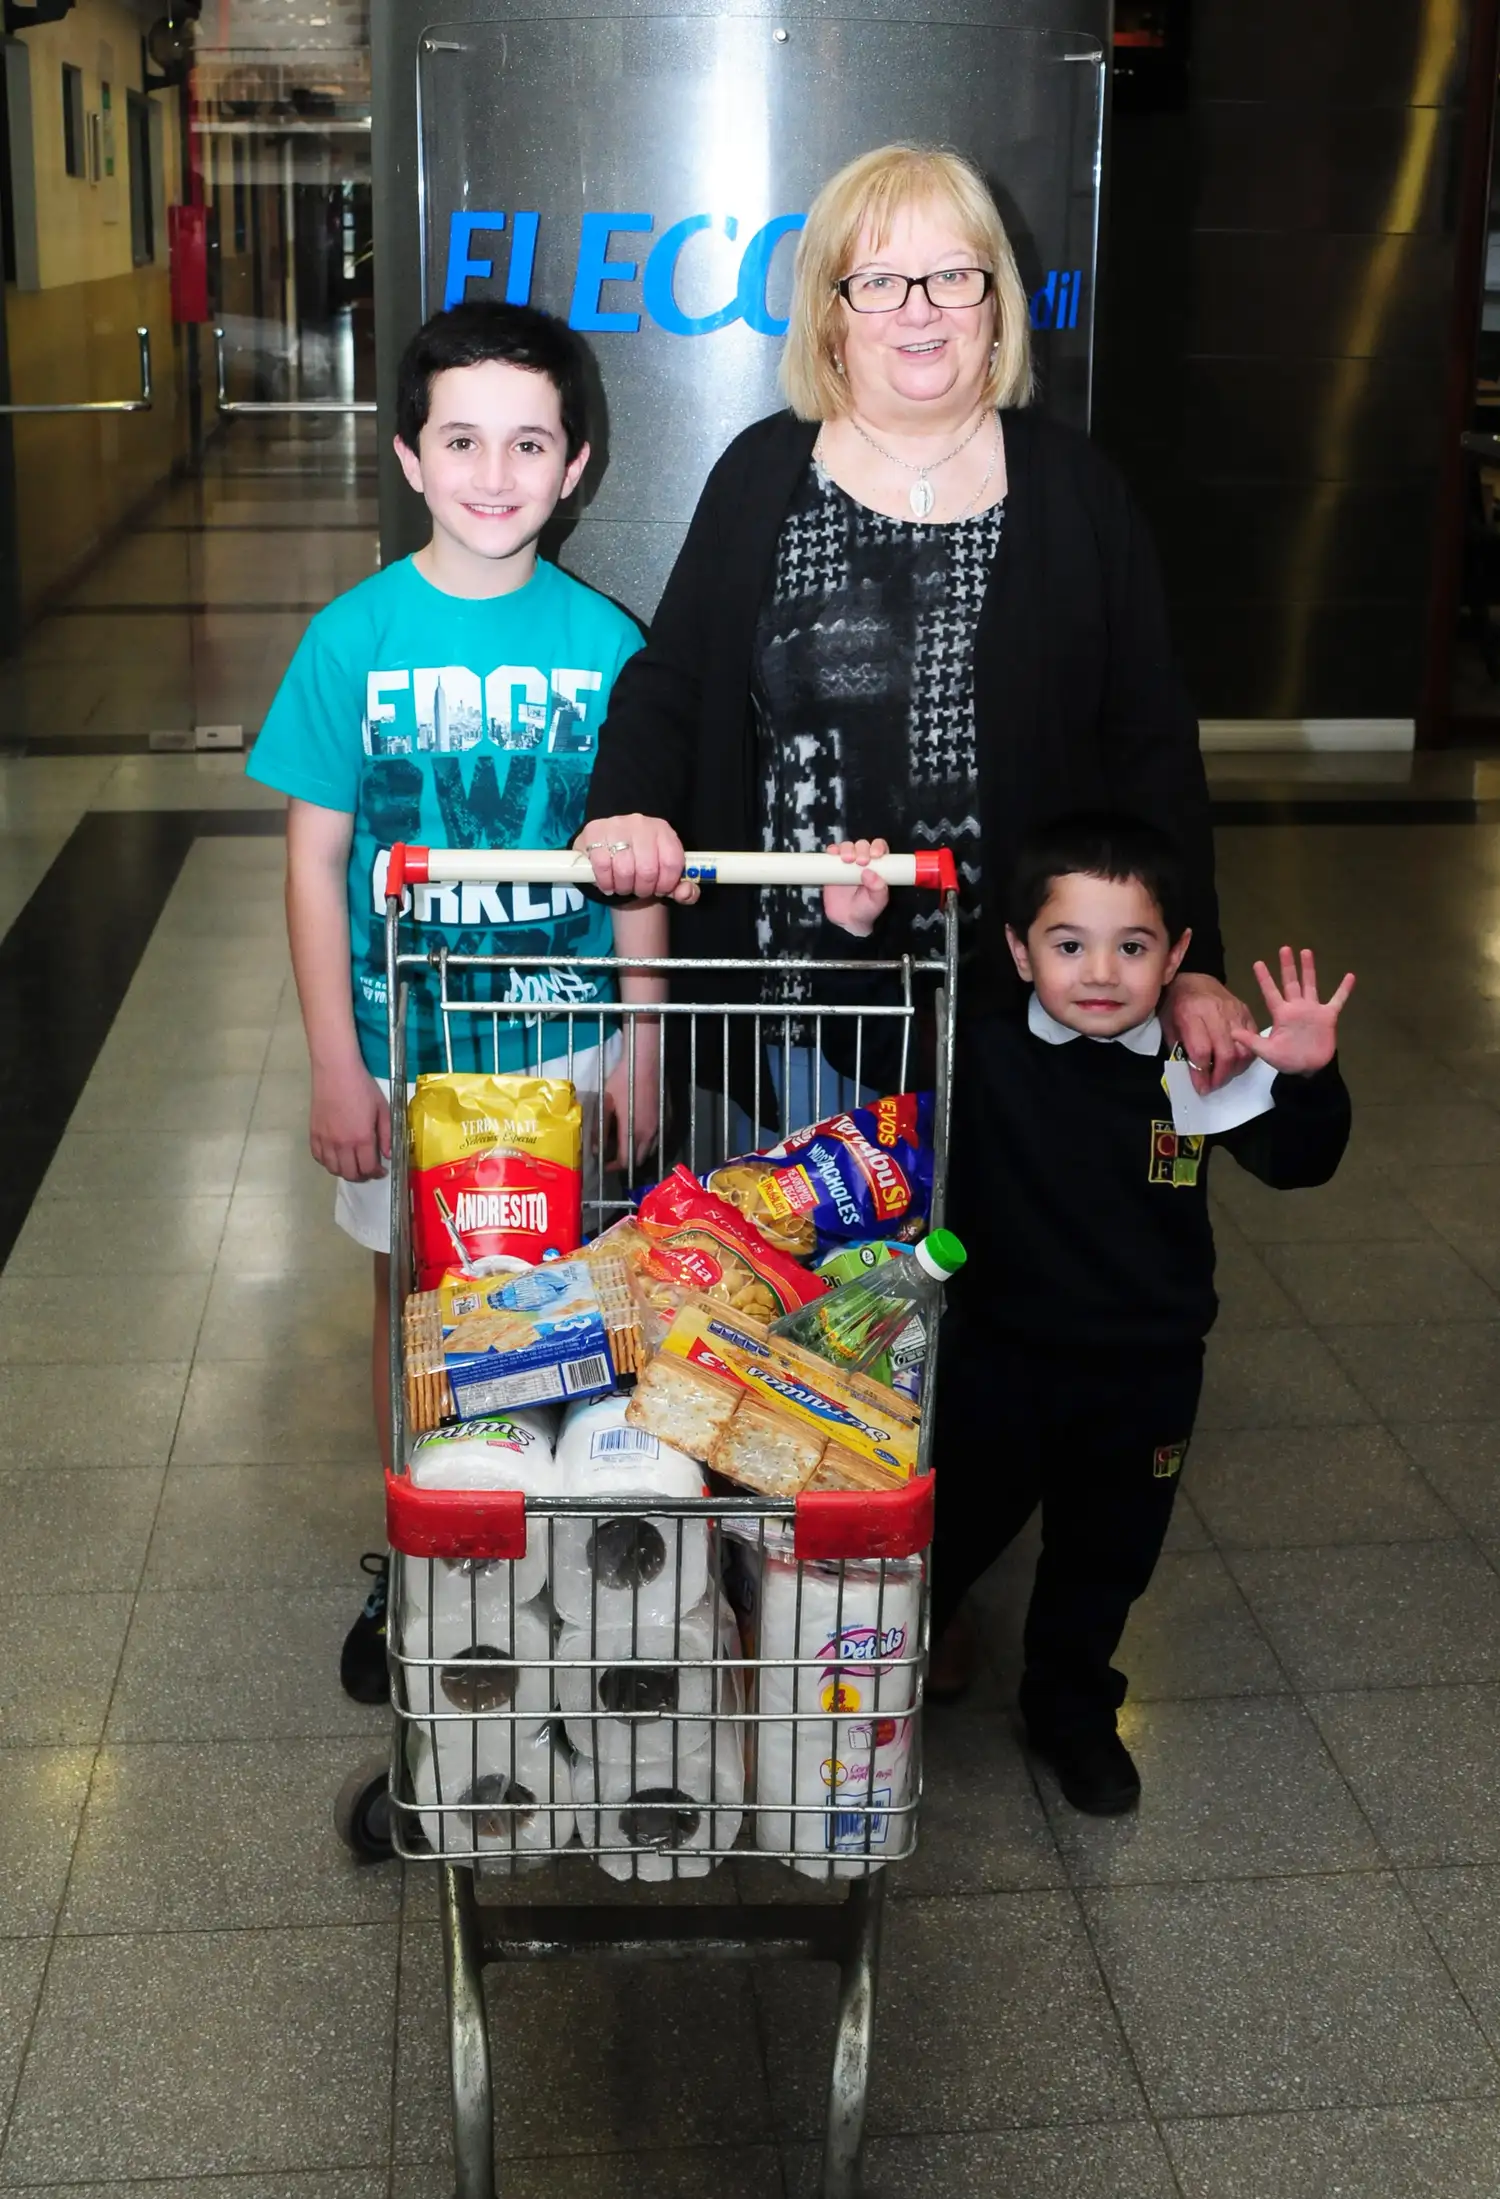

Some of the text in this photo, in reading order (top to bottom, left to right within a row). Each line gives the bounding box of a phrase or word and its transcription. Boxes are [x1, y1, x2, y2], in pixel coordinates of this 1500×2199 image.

[1028, 270, 1082, 330] dil
[362, 664, 603, 756] EDGE
[461, 1117, 538, 1136] YERBA MATE
[455, 1191, 548, 1234] ANDRESITO
[807, 1143, 860, 1225] MOSTACHOLES
[746, 1365, 892, 1443] Serranitas
